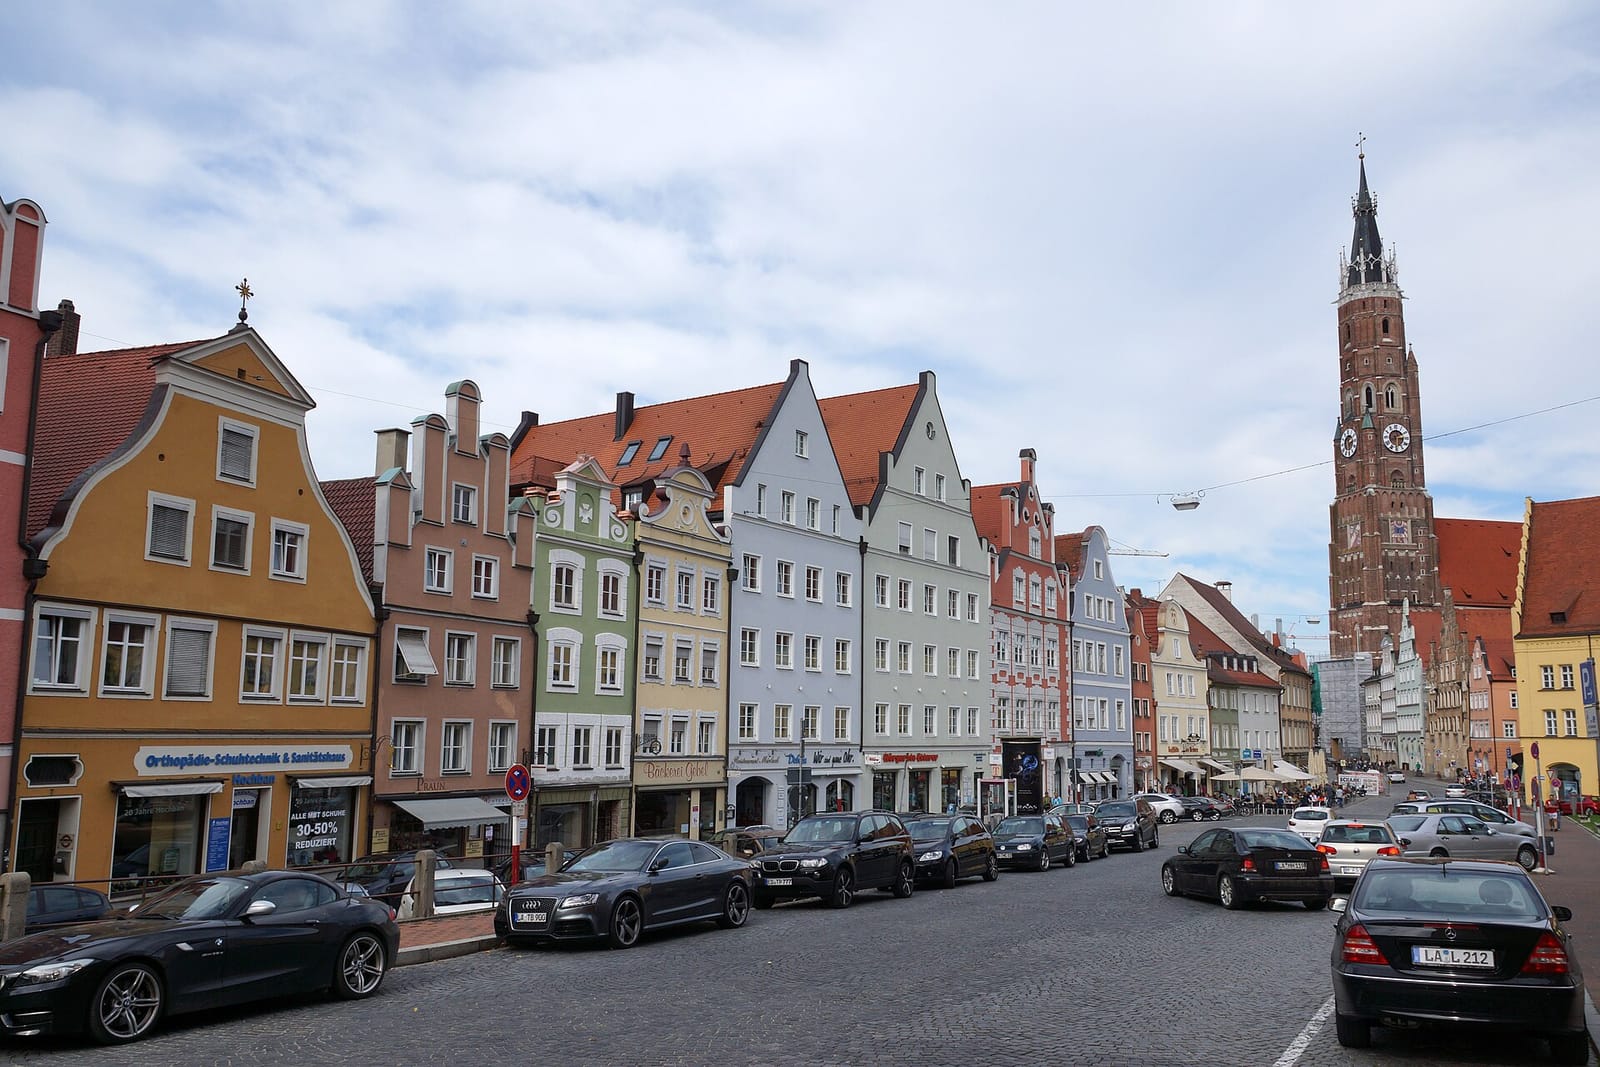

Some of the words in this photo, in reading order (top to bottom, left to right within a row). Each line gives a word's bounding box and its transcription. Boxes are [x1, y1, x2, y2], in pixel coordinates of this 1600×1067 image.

[145, 753, 280, 769] Orthopädie-Schuhtechnik
[282, 752, 290, 763] &
[291, 751, 346, 764] Sanitätshaus
[643, 761, 683, 779] Bäckerei
[291, 812, 307, 820] ALLE
[322, 809, 346, 818] SCHUHE
[296, 821, 338, 837] 30-50%
[295, 837, 337, 850] REDUZIERT
[1424, 949, 1442, 962] LA
[1450, 951, 1460, 963] L
[1463, 951, 1489, 965] 212
